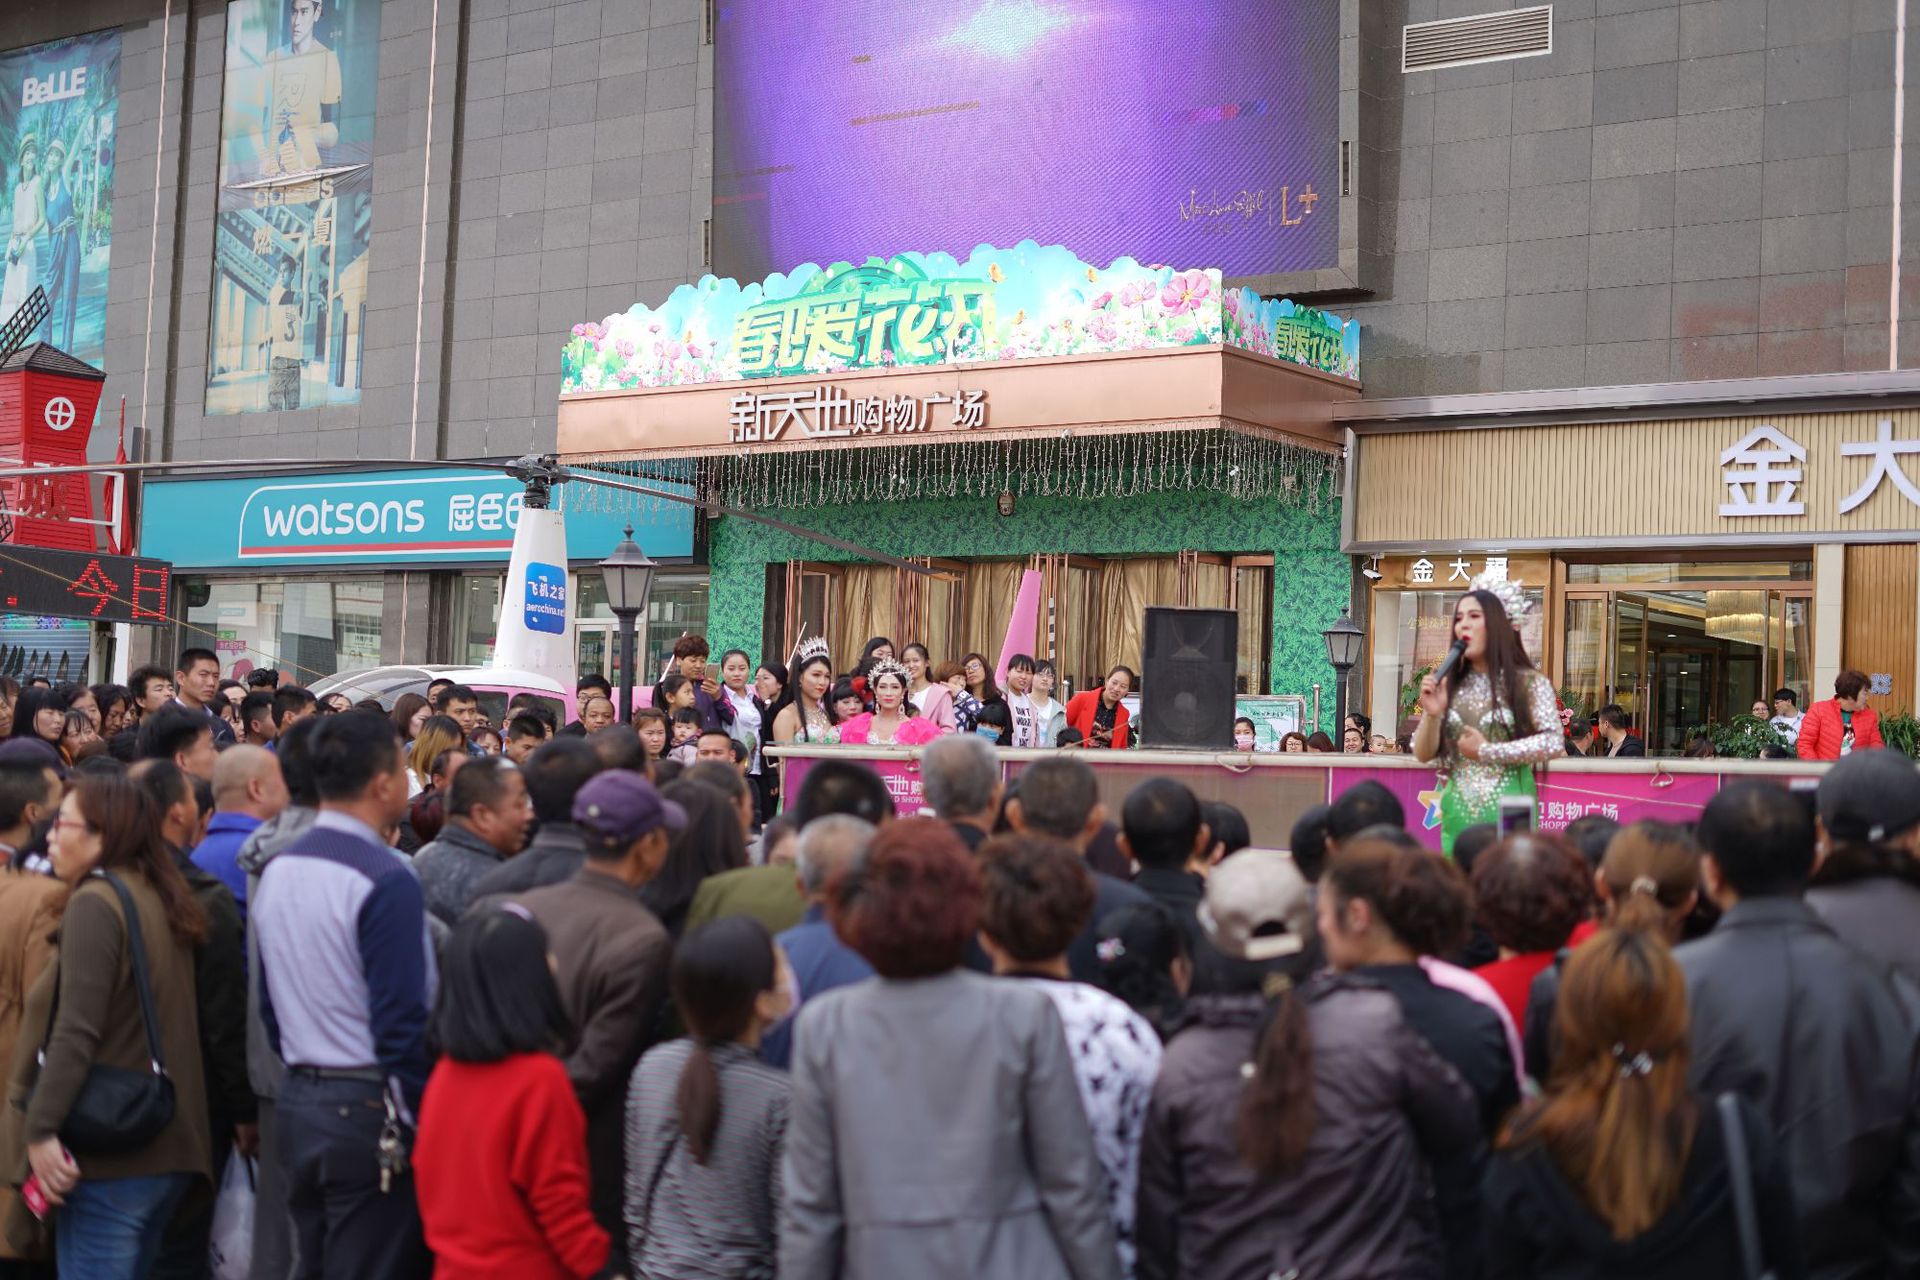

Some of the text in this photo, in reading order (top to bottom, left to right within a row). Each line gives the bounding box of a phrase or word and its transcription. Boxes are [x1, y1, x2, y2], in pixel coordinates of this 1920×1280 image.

[732, 281, 998, 371] 春暖花开
[263, 499, 425, 537] watsons
[67, 559, 169, 622] 今日
